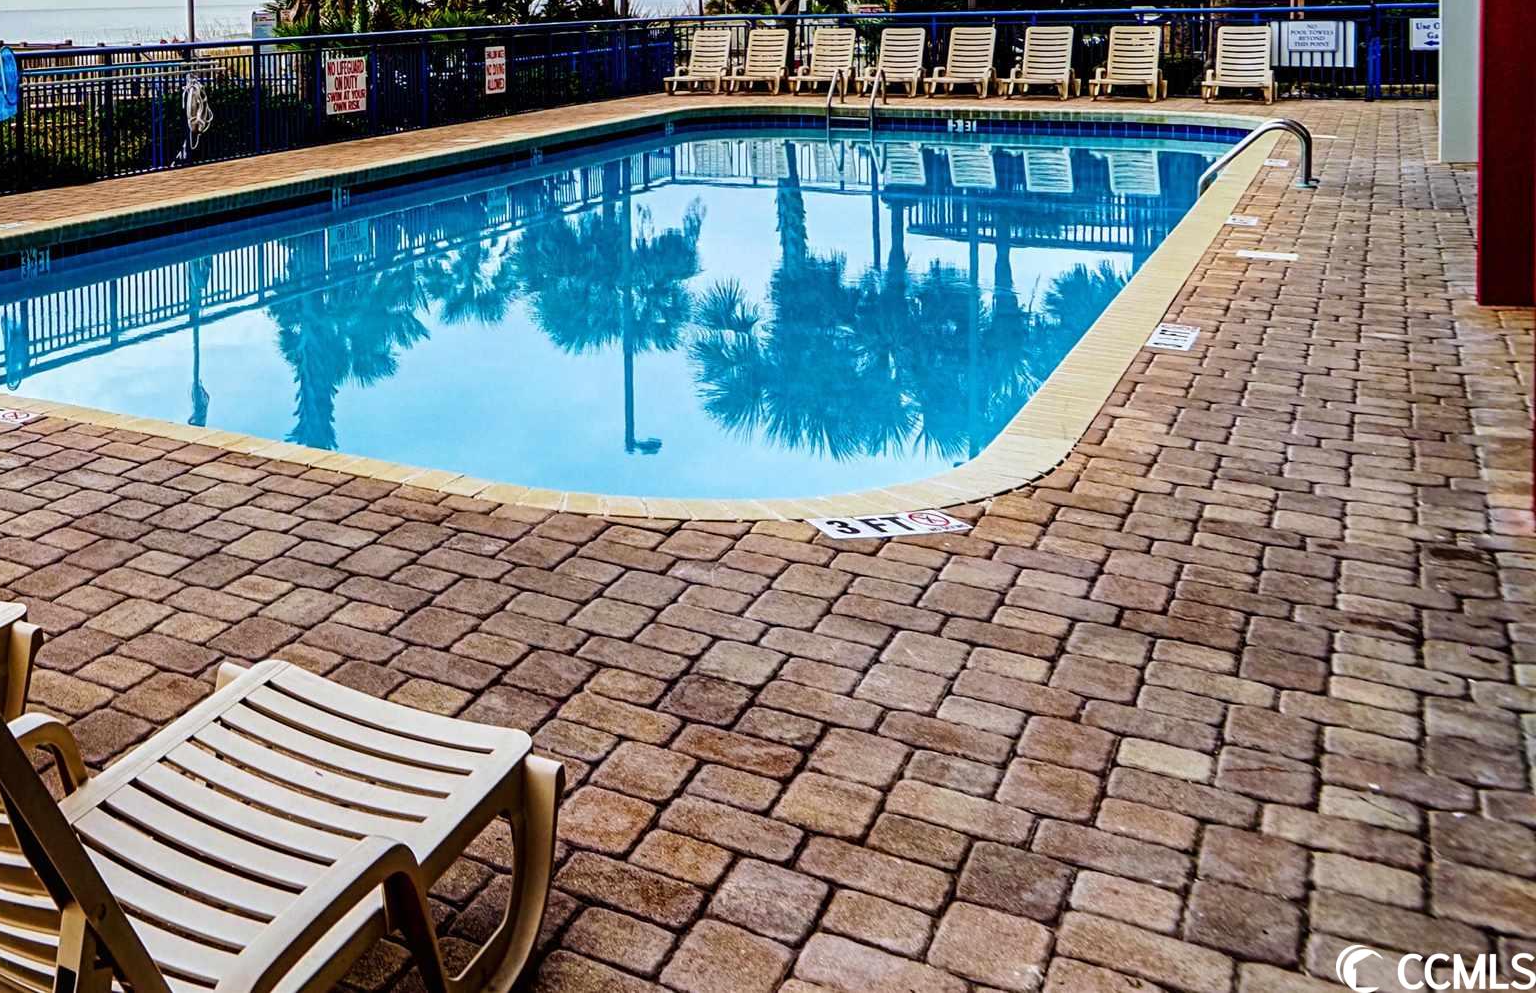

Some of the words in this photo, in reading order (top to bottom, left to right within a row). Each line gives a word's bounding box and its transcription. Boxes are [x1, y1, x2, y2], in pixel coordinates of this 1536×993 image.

[1416, 22, 1431, 30] Use
[327, 61, 335, 76] NO
[336, 59, 365, 75] LIFEGUARD
[335, 76, 343, 91] ON
[343, 75, 358, 89] DUTY
[343, 90, 350, 100] AT
[352, 89, 366, 99] YOUR
[333, 102, 347, 112] OWN
[347, 100, 360, 110] RISK
[826, 520, 861, 534] 3
[858, 516, 916, 533] FT
